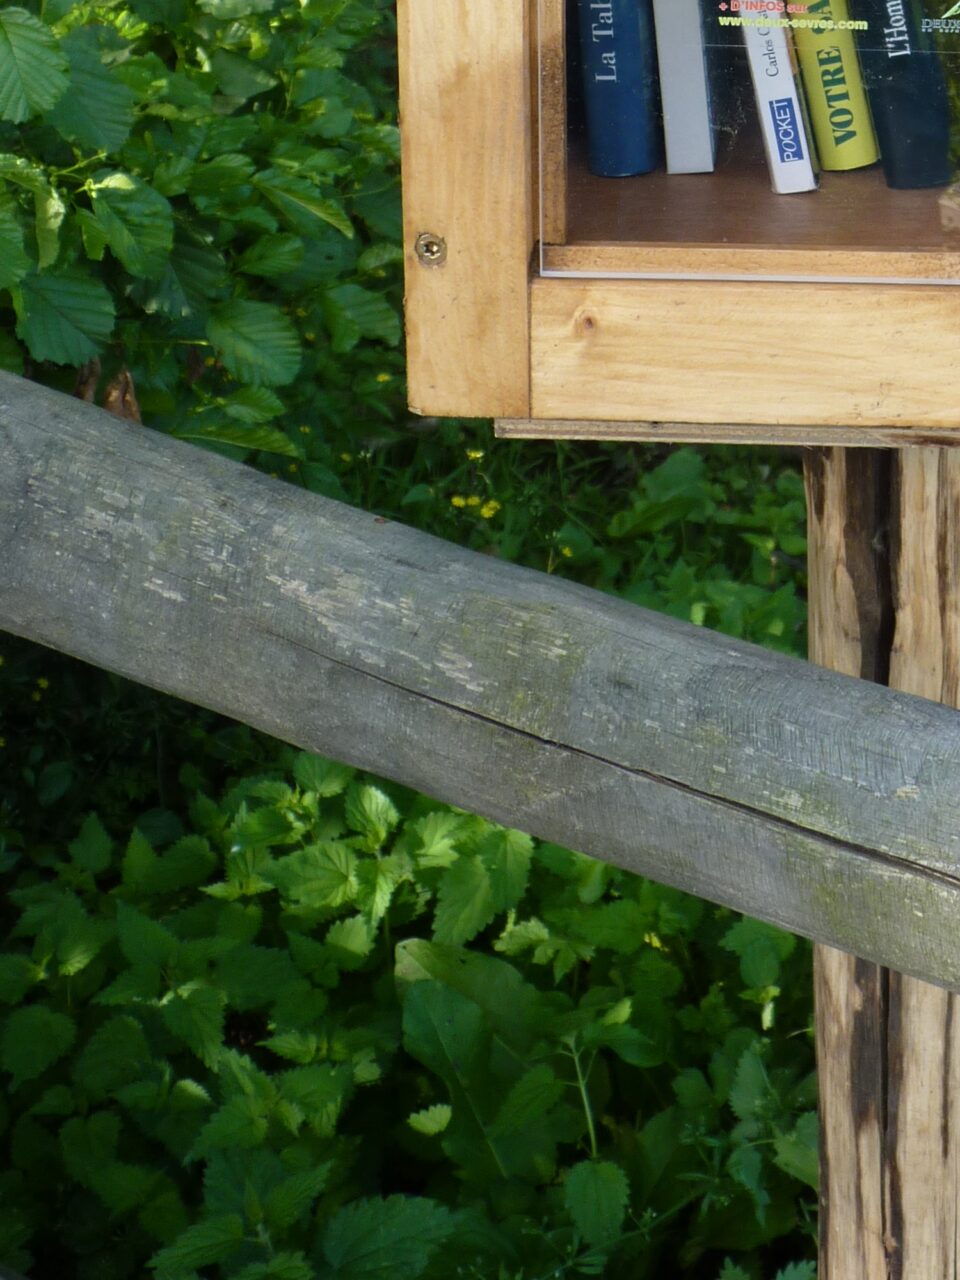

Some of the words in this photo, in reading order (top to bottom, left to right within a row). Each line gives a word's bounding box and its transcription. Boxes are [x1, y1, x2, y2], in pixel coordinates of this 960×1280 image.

[718, 15, 869, 31] www.deux-sevres.com
[730, 0, 785, 13] D'INFOS
[595, 51, 617, 83] La
[761, 40, 780, 77] Carlos
[816, 45, 858, 147] VOTRE
[773, 99, 800, 162] POCKET
